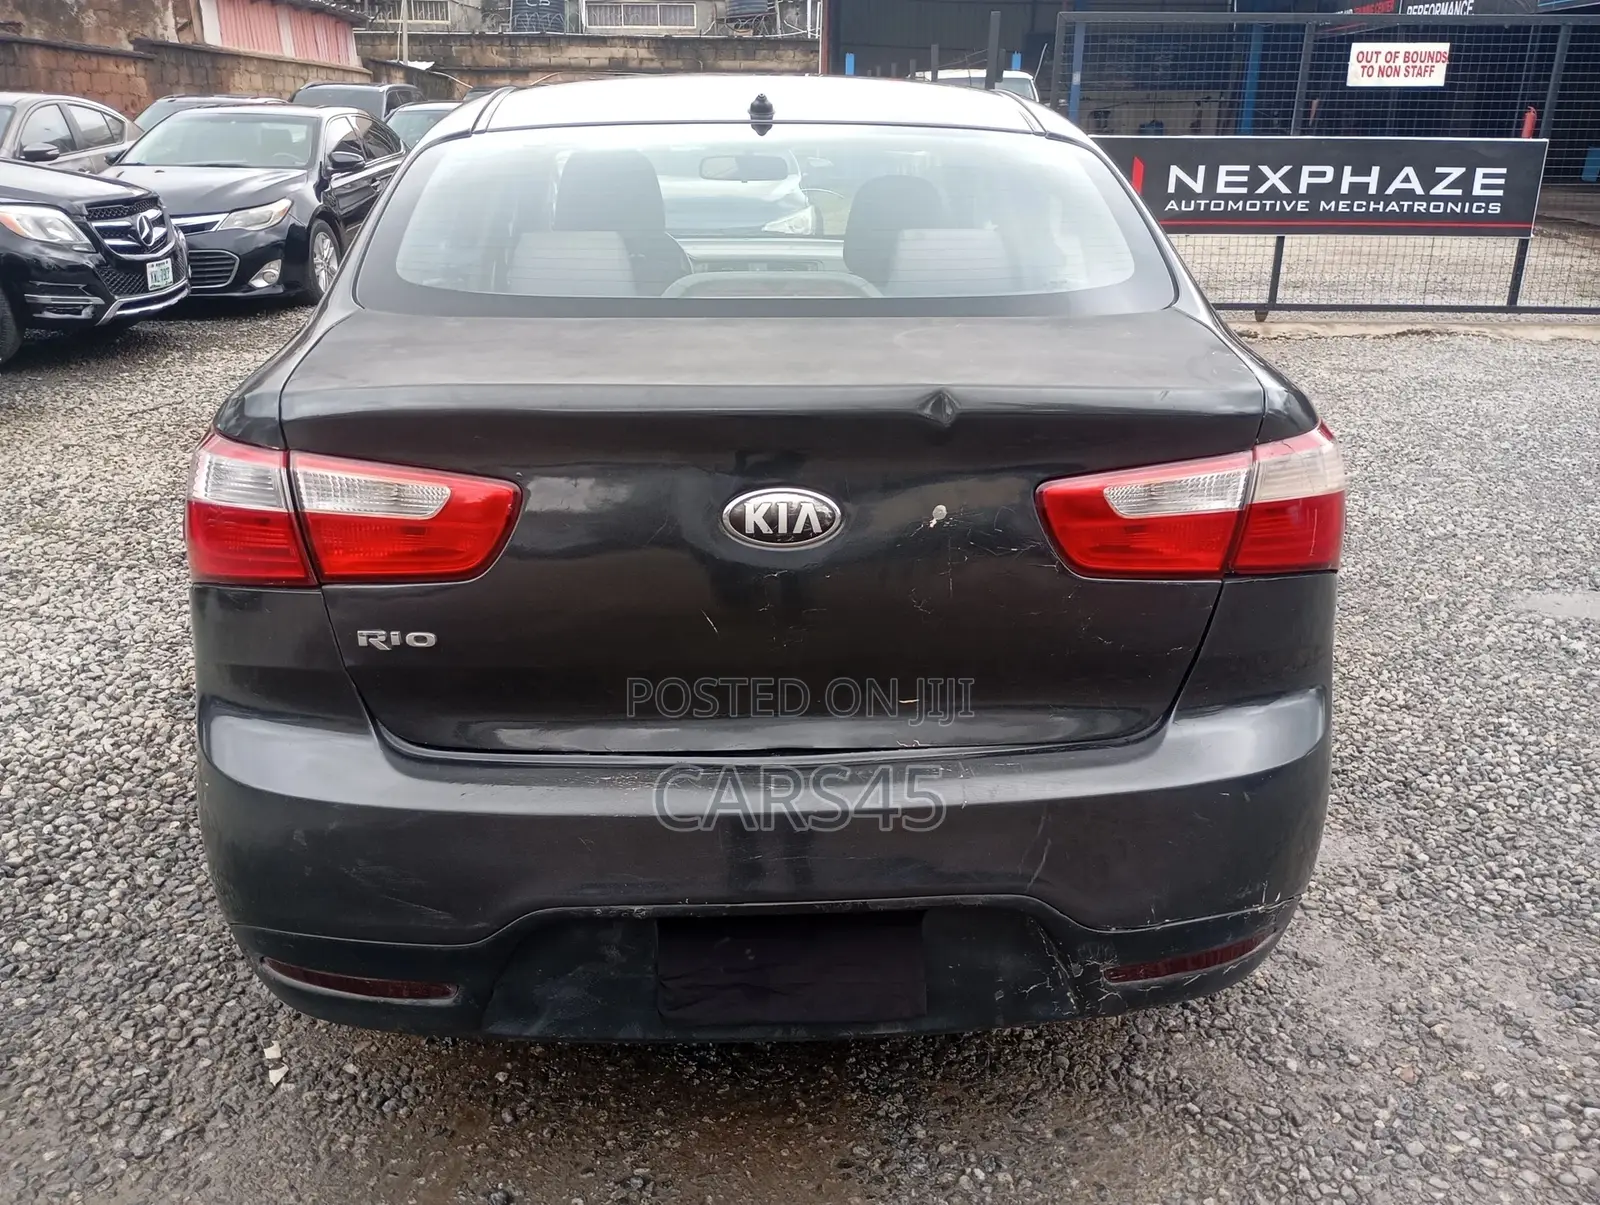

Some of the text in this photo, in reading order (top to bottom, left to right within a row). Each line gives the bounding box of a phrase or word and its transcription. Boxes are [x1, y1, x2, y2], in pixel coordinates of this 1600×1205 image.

[1356, 51, 1448, 64] OUT OF BOUNDS
[1361, 65, 1435, 77] TO NON STAFF
[1167, 164, 1507, 196] NEXPHAZE
[1164, 199, 1502, 215] AUTOMOTIVE MECHATRONICS
[745, 502, 823, 535] KIA
[357, 629, 438, 650] RIO
